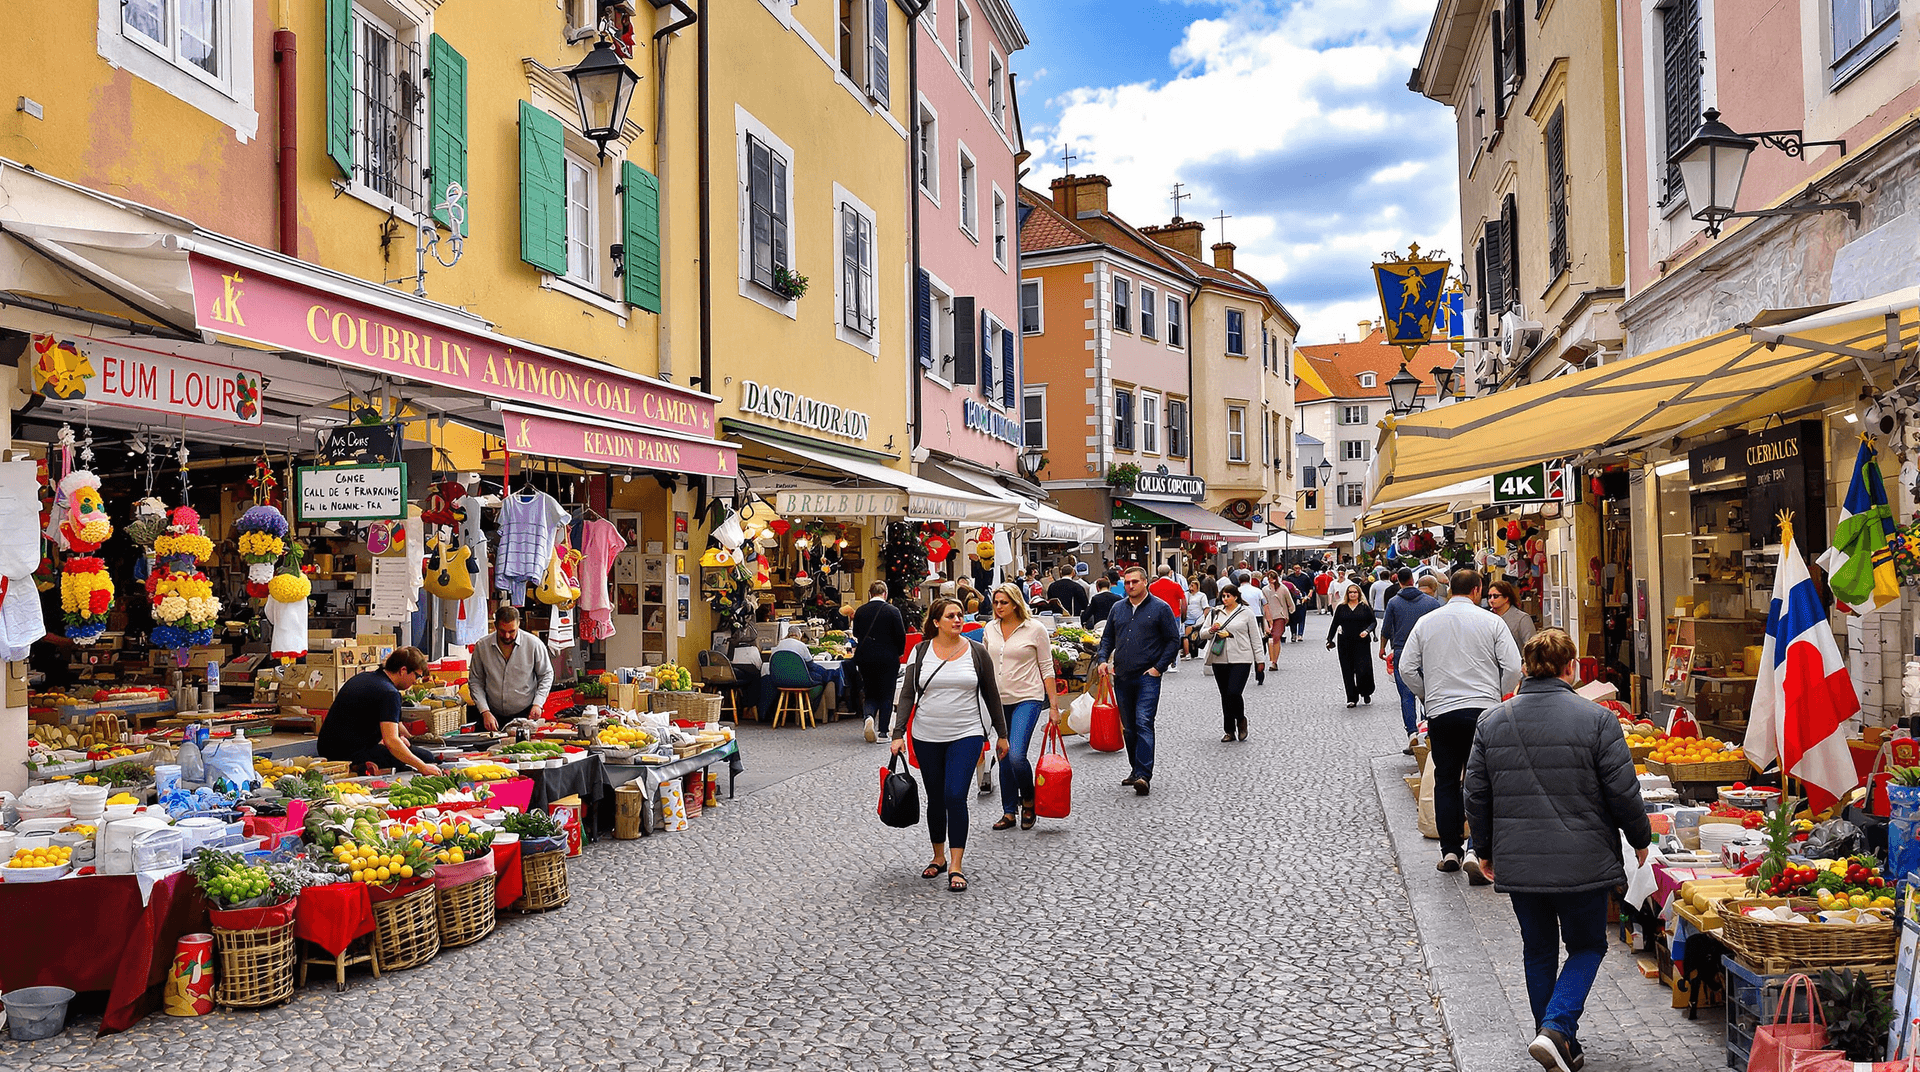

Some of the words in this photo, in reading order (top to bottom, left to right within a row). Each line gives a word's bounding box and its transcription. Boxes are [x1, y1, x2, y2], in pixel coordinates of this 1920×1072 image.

[306, 305, 471, 378] COUBRLIN
[102, 356, 157, 400] EUM
[169, 369, 236, 412] LOUR
[638, 439, 680, 464] PARNS
[1500, 475, 1537, 496] 4K
